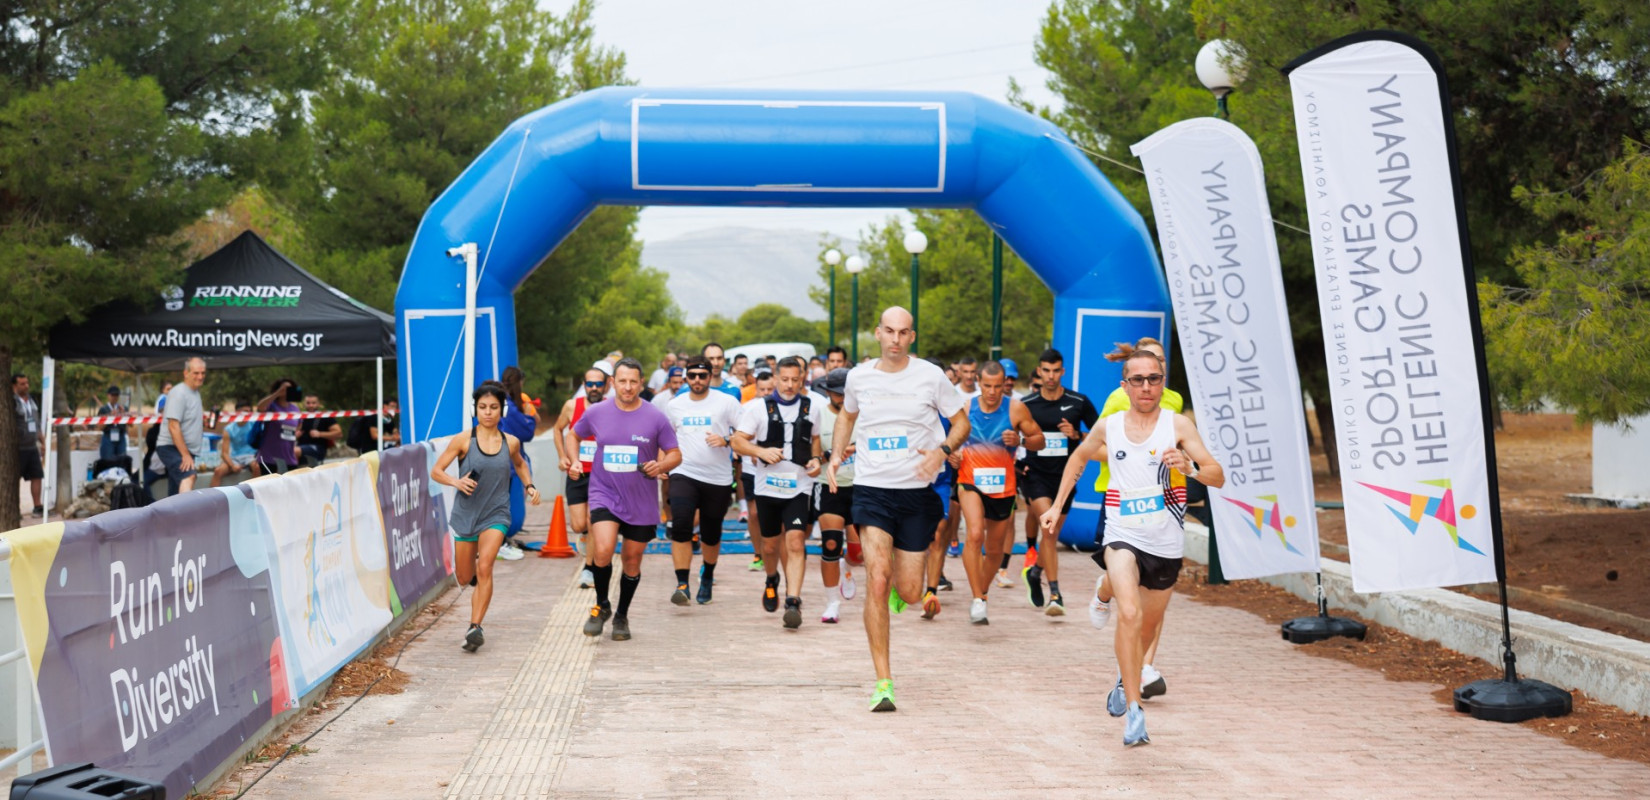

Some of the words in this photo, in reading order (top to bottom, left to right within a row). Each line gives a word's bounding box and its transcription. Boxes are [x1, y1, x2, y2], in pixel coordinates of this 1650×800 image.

[193, 285, 302, 298] RUNNING
[189, 296, 300, 307] NEWS.GR
[110, 329, 323, 351] www.RunningNews.gr
[687, 416, 706, 425] 113
[875, 438, 900, 449] 147
[610, 454, 631, 463] 110
[980, 475, 1001, 485] 214
[391, 473, 409, 517] Run
[409, 468, 420, 511] for
[1126, 498, 1158, 513] 104
[392, 520, 426, 571] Diversity
[110, 560, 164, 648] Run
[171, 540, 207, 619] for
[110, 635, 220, 753] Diversity
